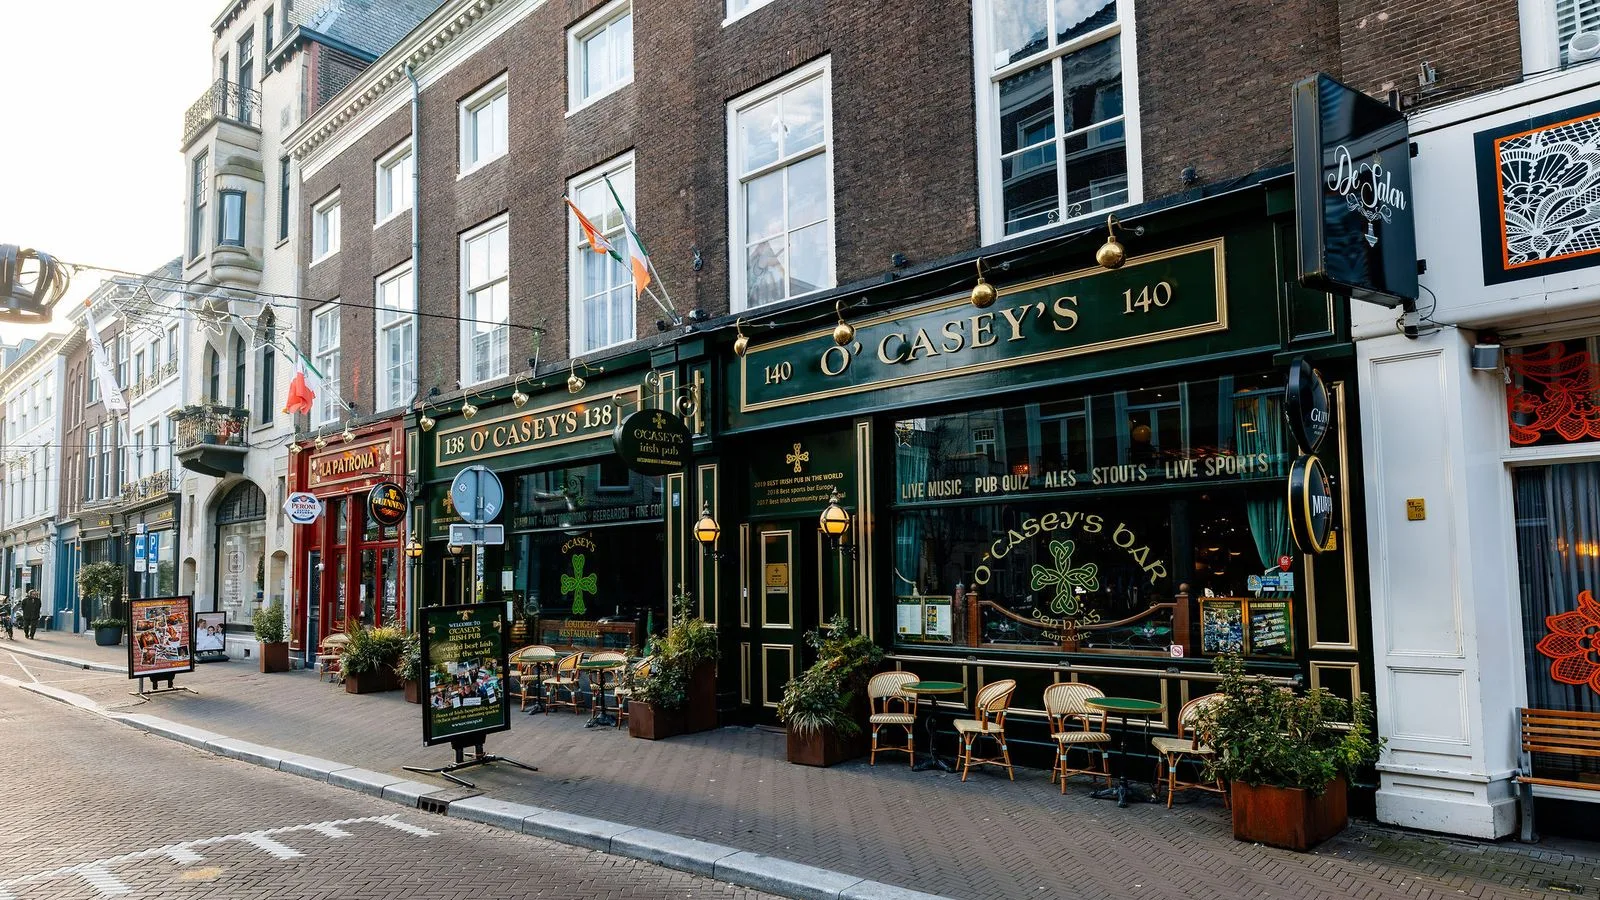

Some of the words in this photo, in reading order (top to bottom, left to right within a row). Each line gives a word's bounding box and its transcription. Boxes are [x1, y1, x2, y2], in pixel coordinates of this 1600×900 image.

[1328, 145, 1360, 196] De
[1360, 163, 1407, 211] Salon
[764, 361, 792, 385] 140
[878, 296, 1079, 365] CASEY'S
[1122, 281, 1172, 315] 140
[445, 436, 465, 455] 138
[493, 410, 578, 448] CASEY'S
[583, 405, 612, 428] 138
[634, 428, 684, 444] O'CASEY'S
[640, 442, 659, 453] irish
[662, 445, 679, 457] pub
[321, 463, 332, 477] LA
[333, 452, 375, 474] PATRONA
[823, 472, 844, 480] WORLD
[902, 482, 924, 499] LIVE
[928, 479, 962, 497] MUSIC
[975, 476, 998, 494] PUB
[1002, 474, 1029, 492] QUIZ
[1044, 469, 1077, 489] ALES
[1092, 463, 1148, 485] STOUTS
[1165, 459, 1198, 480] LIVE
[1205, 453, 1269, 477] SPORTS
[818, 494, 829, 502] pub
[636, 504, 649, 518] FINE
[449, 626, 481, 635] O'CASEY'S
[468, 632, 481, 640] PUB
